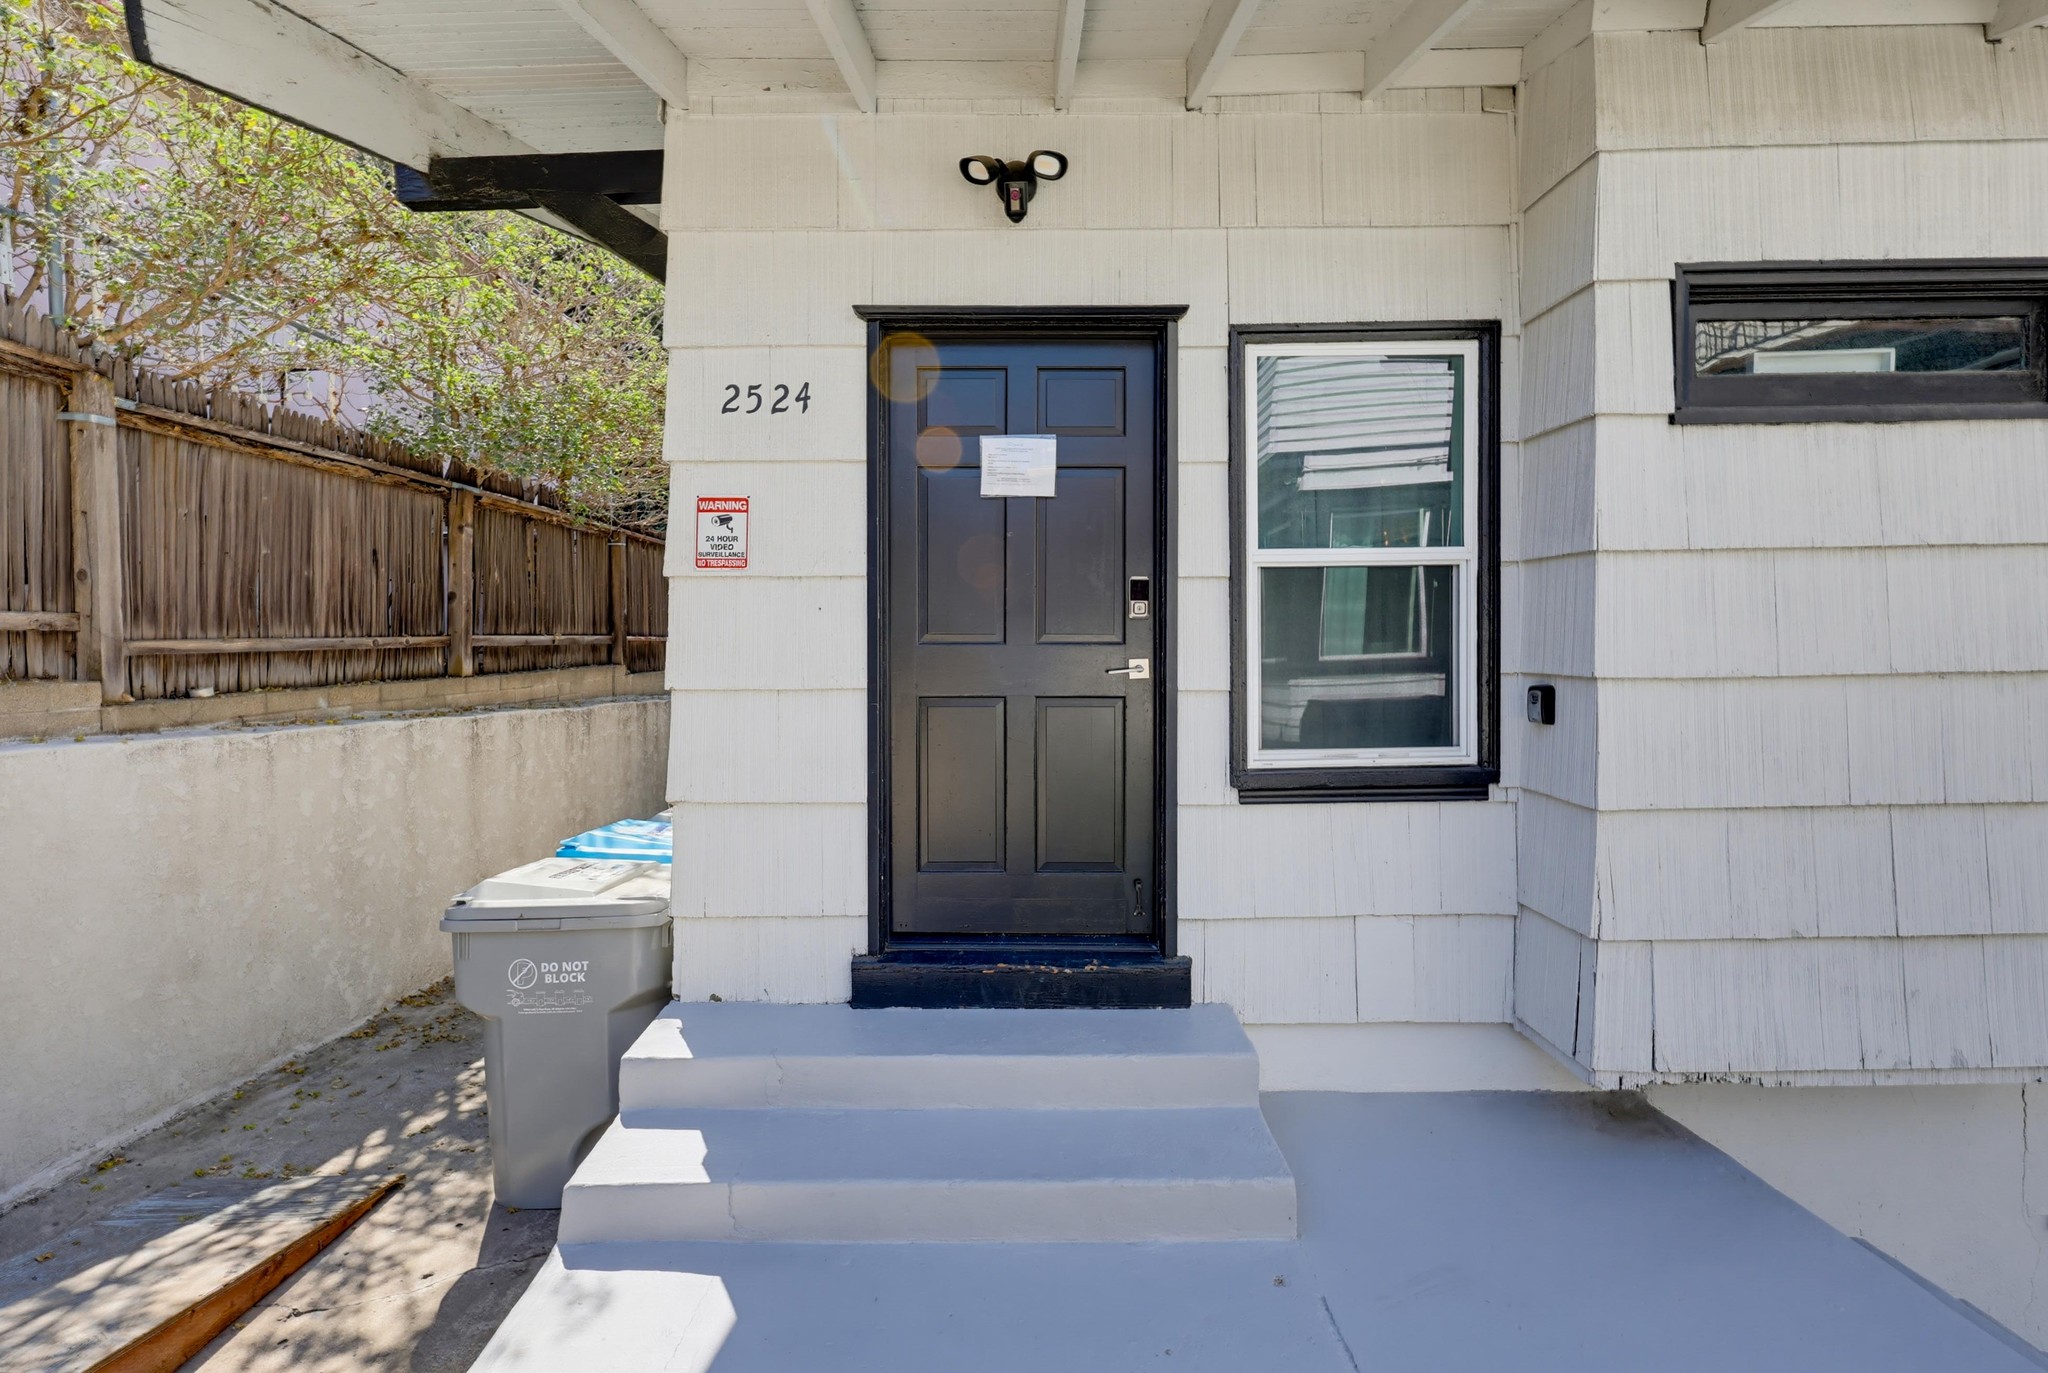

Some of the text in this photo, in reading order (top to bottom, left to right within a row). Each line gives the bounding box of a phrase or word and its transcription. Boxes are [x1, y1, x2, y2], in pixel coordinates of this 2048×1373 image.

[721, 381, 811, 415] 2524
[698, 500, 748, 511] WARNING
[710, 543, 734, 551] VIDEO
[697, 559, 746, 567] NO TRESPASSING
[540, 960, 589, 973] DO NOT
[544, 972, 586, 984] BLOCK
